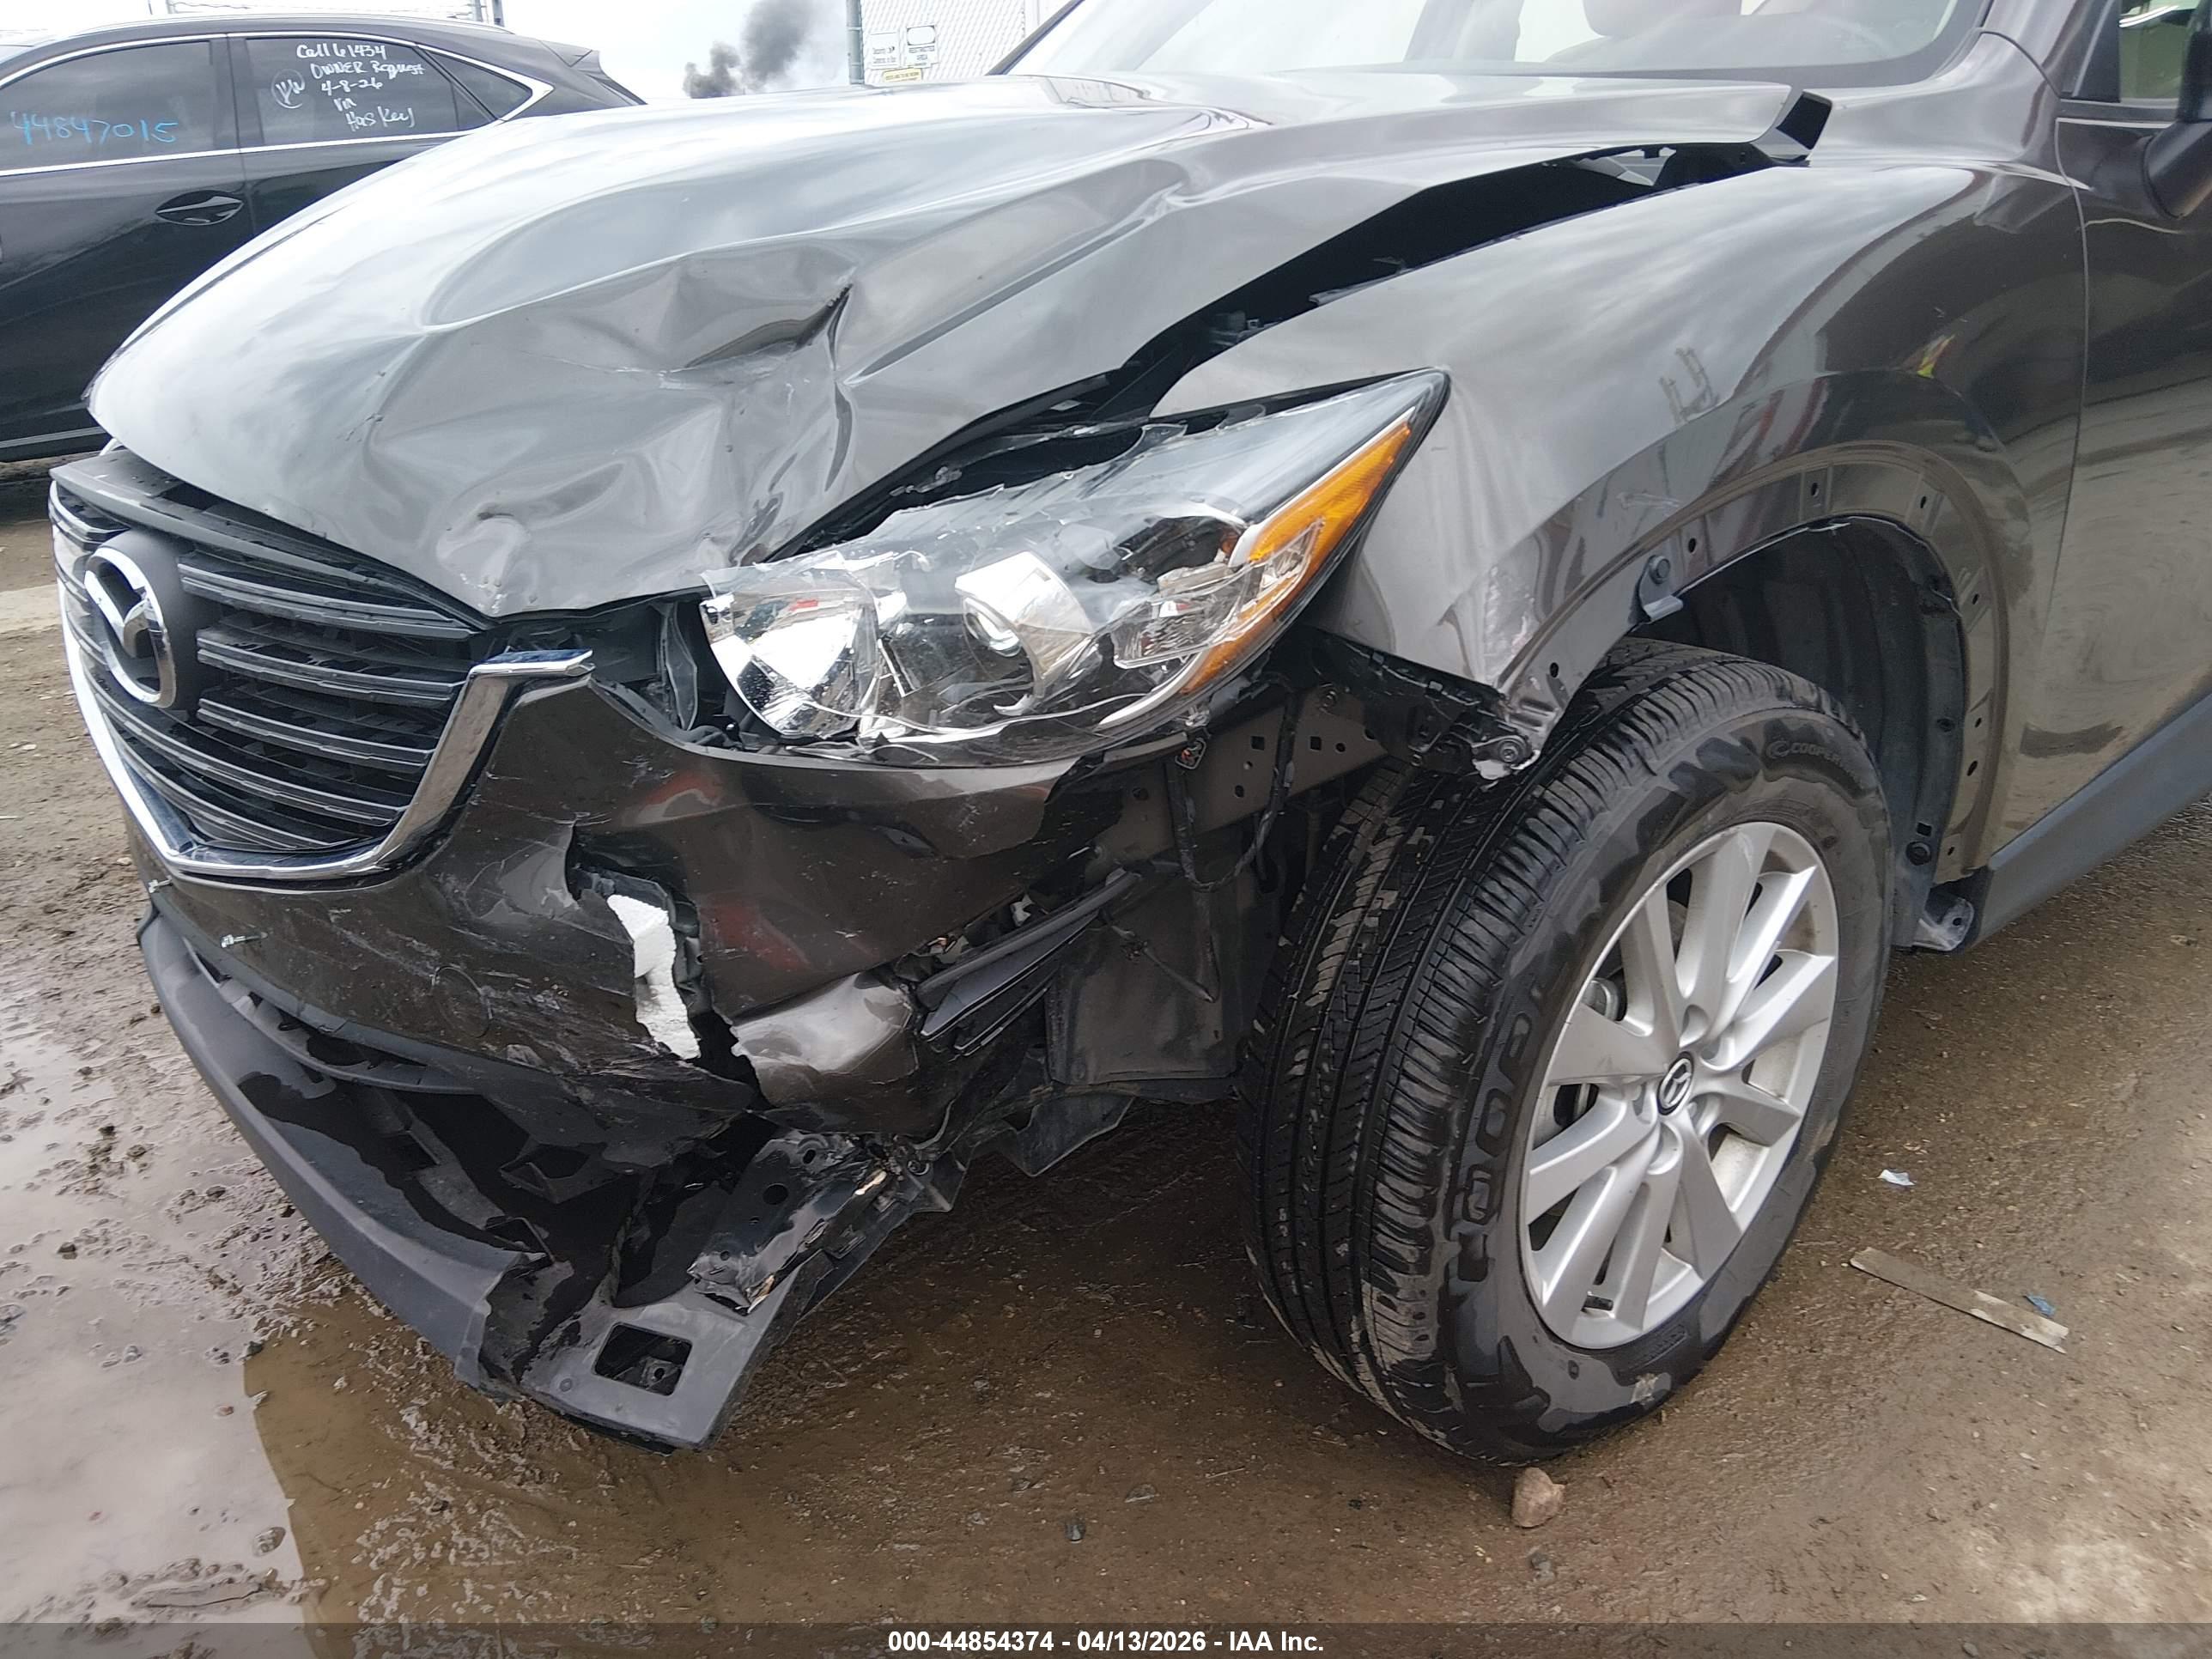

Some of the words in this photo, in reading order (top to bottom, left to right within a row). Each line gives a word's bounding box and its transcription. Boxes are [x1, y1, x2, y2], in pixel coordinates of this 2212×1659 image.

[296, 43, 331, 58] Call
[332, 43, 387, 60] 61434
[310, 61, 368, 79] OWNER
[320, 76, 383, 96] 4-8-26
[9, 110, 179, 145] 44847015
